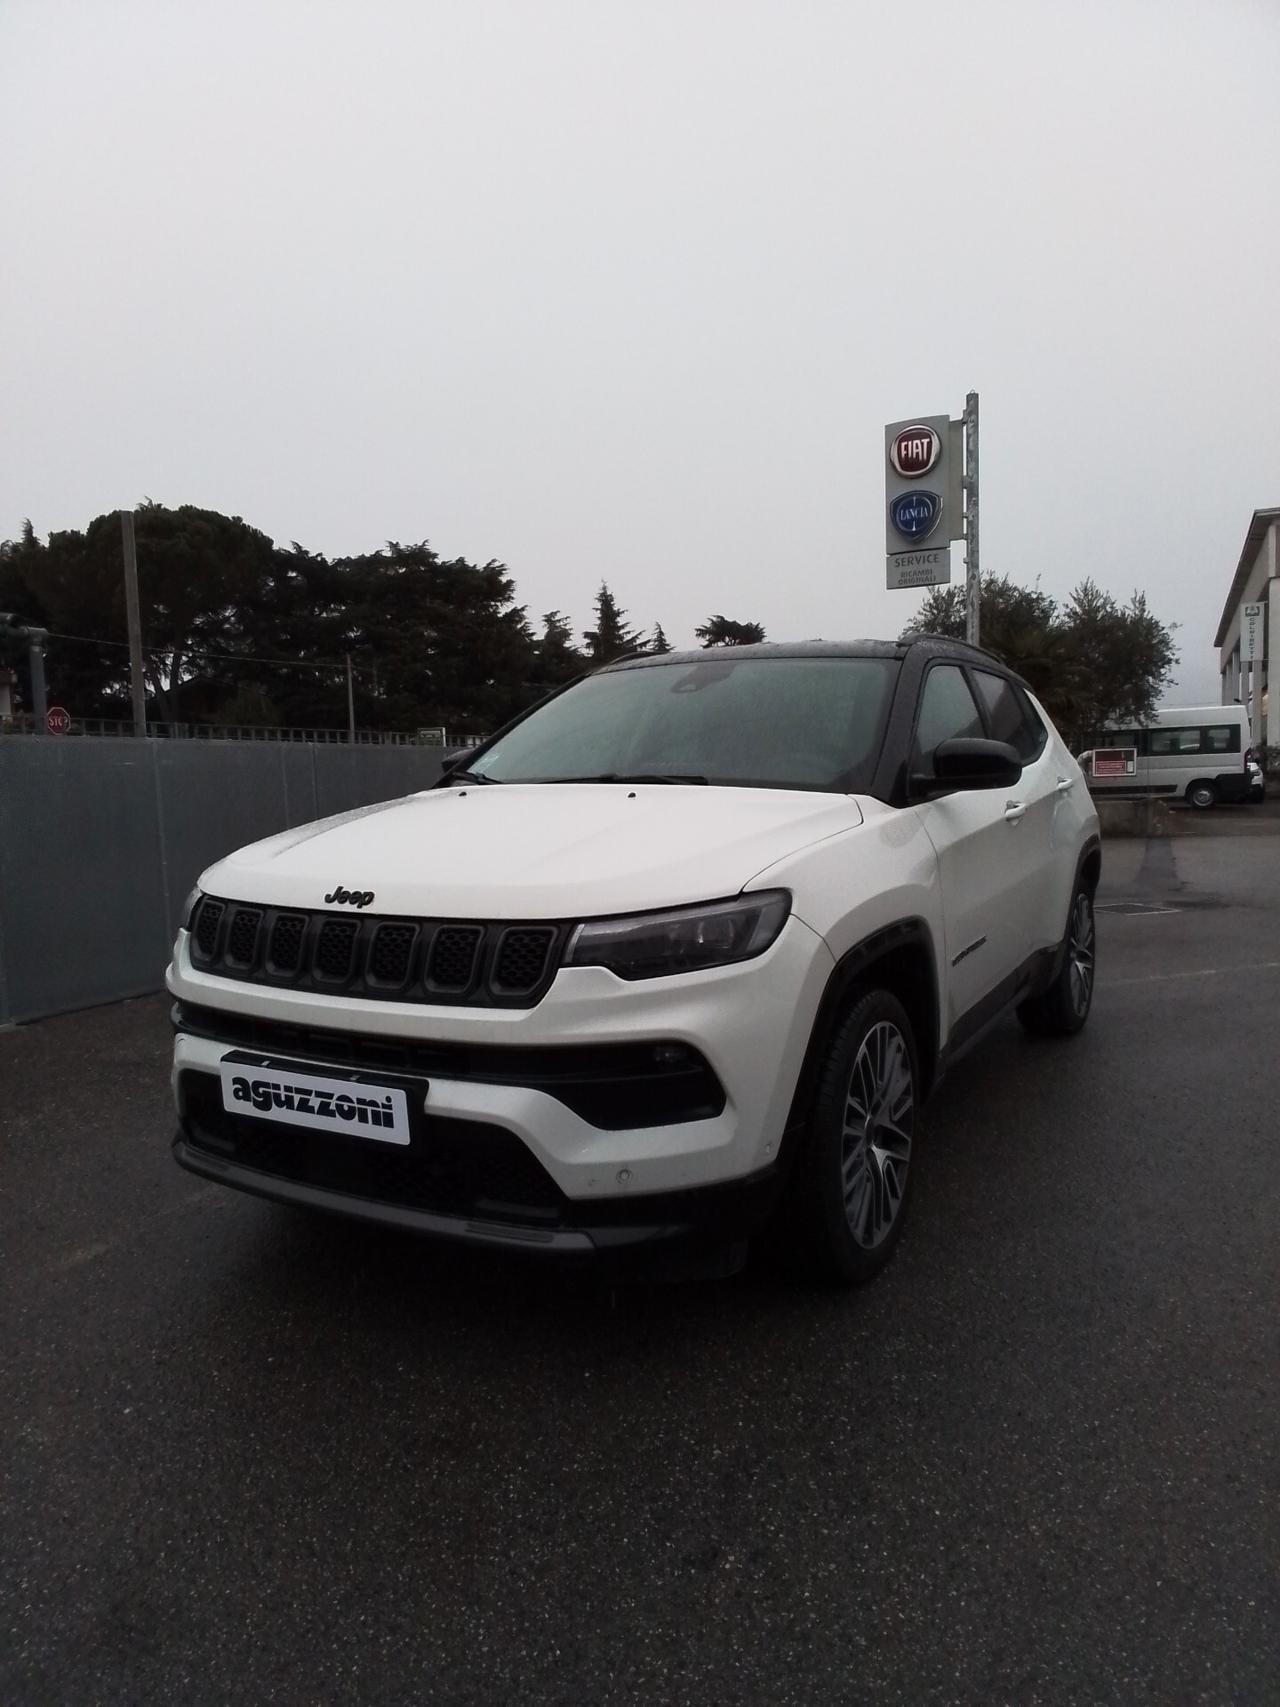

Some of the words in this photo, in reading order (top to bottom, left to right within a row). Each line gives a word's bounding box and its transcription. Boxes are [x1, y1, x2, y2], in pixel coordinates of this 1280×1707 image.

[901, 438, 930, 461] FIAT
[900, 506, 929, 522] LANCIA
[895, 553, 939, 568] SERVICE
[324, 886, 375, 909] Jeep
[231, 1075, 394, 1128] aguzzoni
